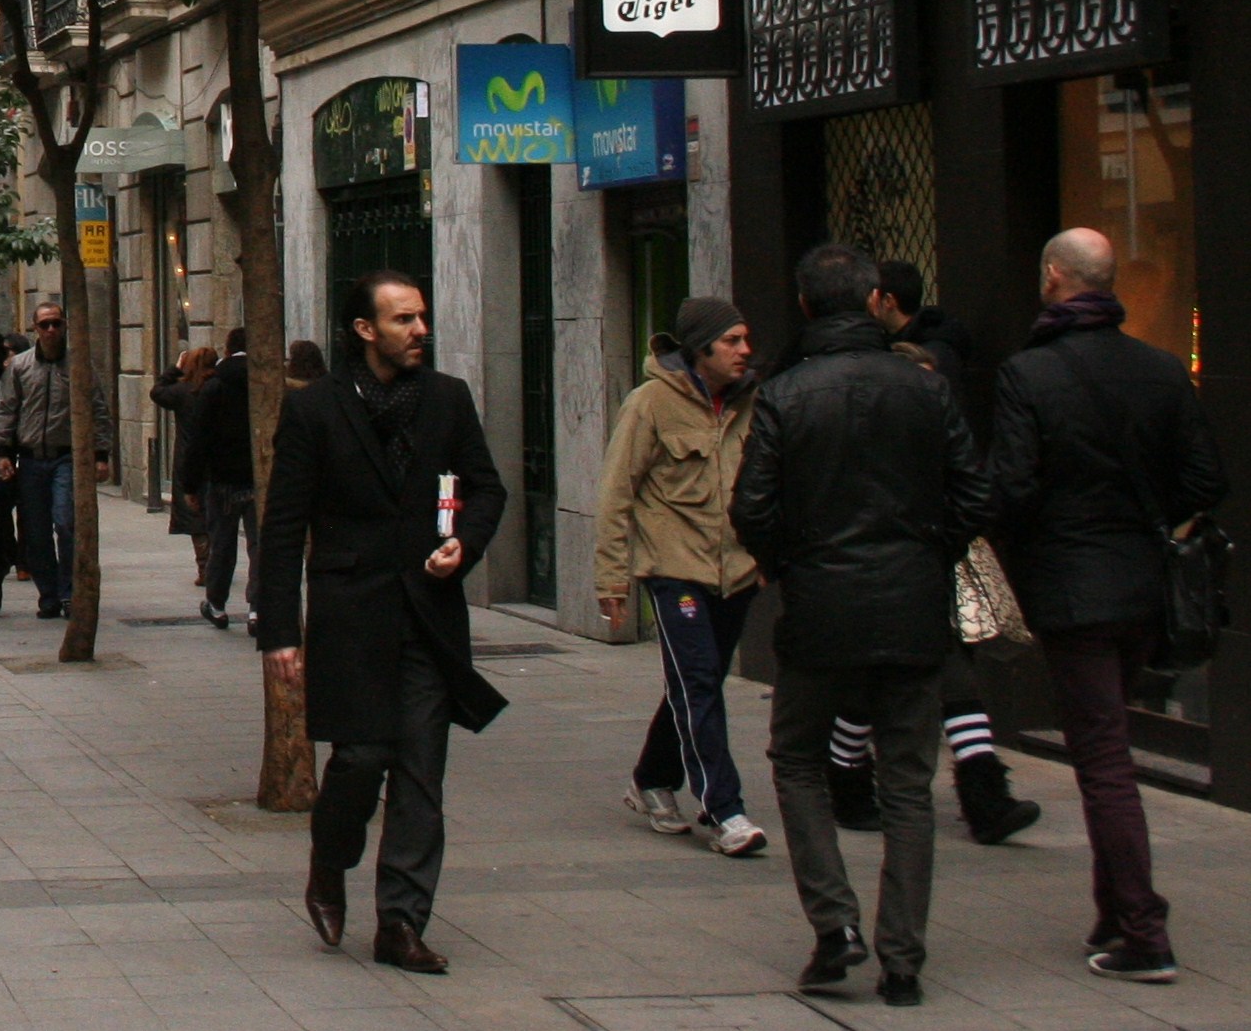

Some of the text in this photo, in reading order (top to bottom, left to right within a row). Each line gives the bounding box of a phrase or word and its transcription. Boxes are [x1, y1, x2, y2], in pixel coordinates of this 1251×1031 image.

[473, 120, 562, 138] movistar
[84, 140, 127, 156] OSS
[592, 123, 638, 158] movistar
